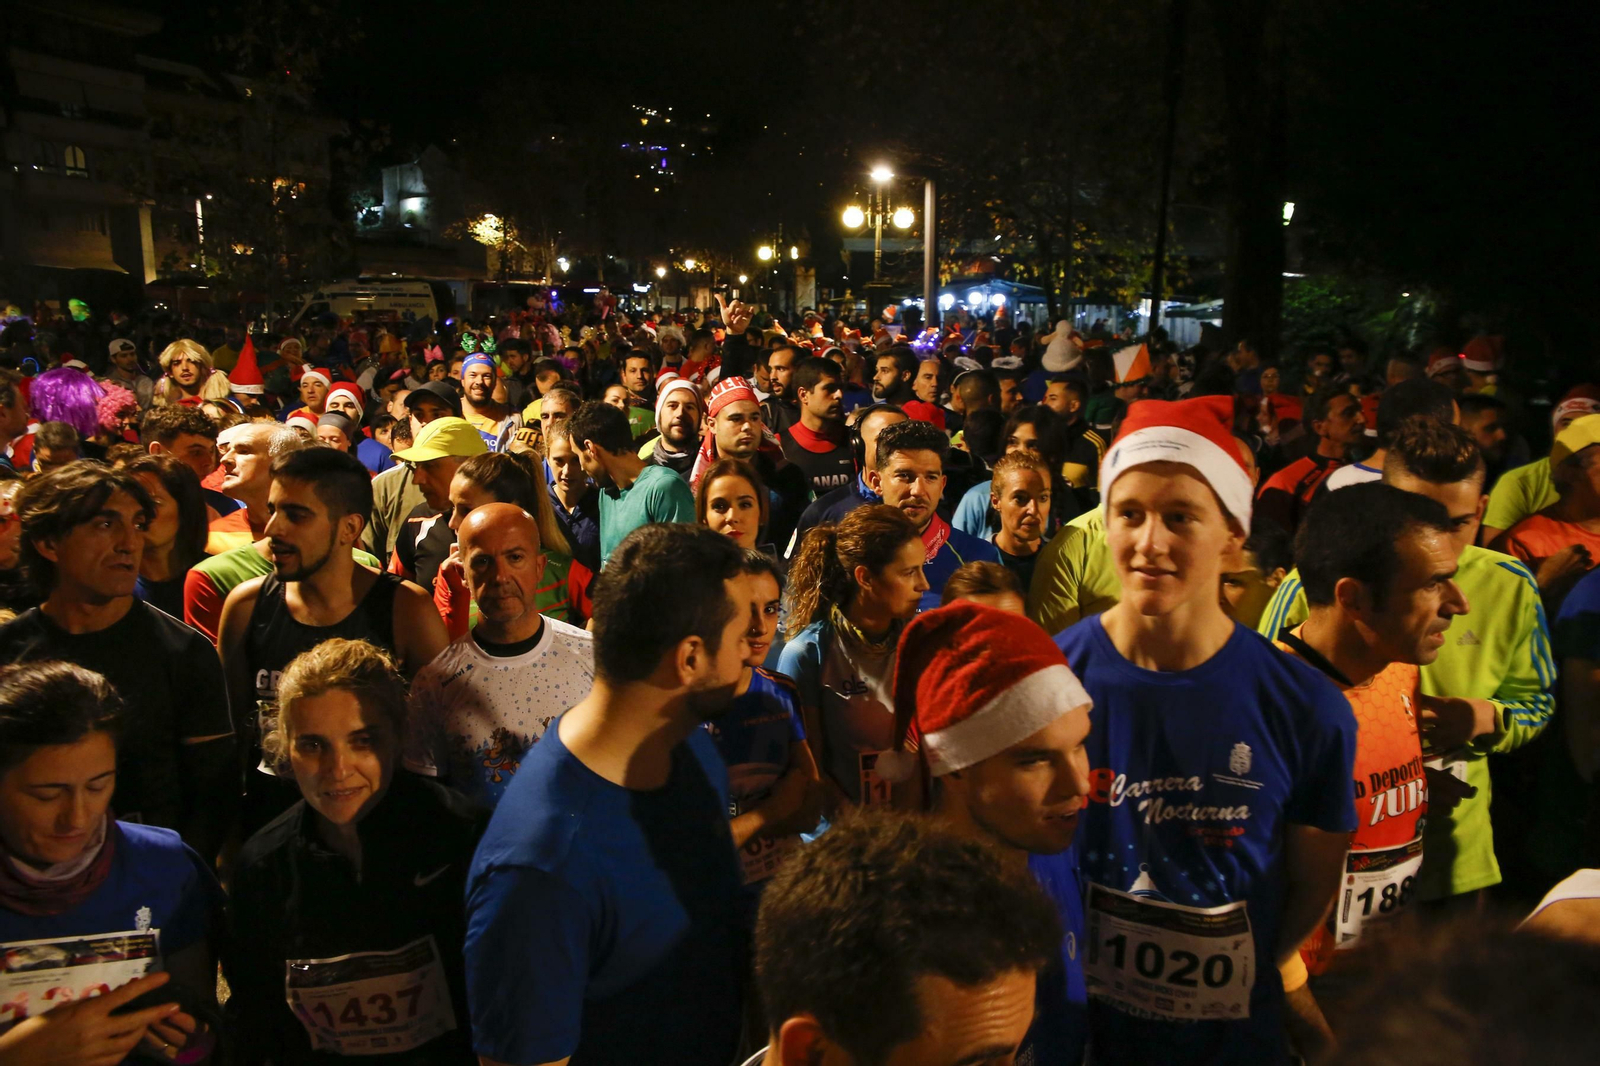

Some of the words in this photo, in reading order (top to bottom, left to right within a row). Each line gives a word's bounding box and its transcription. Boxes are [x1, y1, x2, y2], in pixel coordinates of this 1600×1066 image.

[1109, 773, 1205, 808] Carrera
[1137, 797, 1252, 825] Nocturna
[1105, 933, 1234, 988] 1020
[312, 984, 424, 1029] 1437
